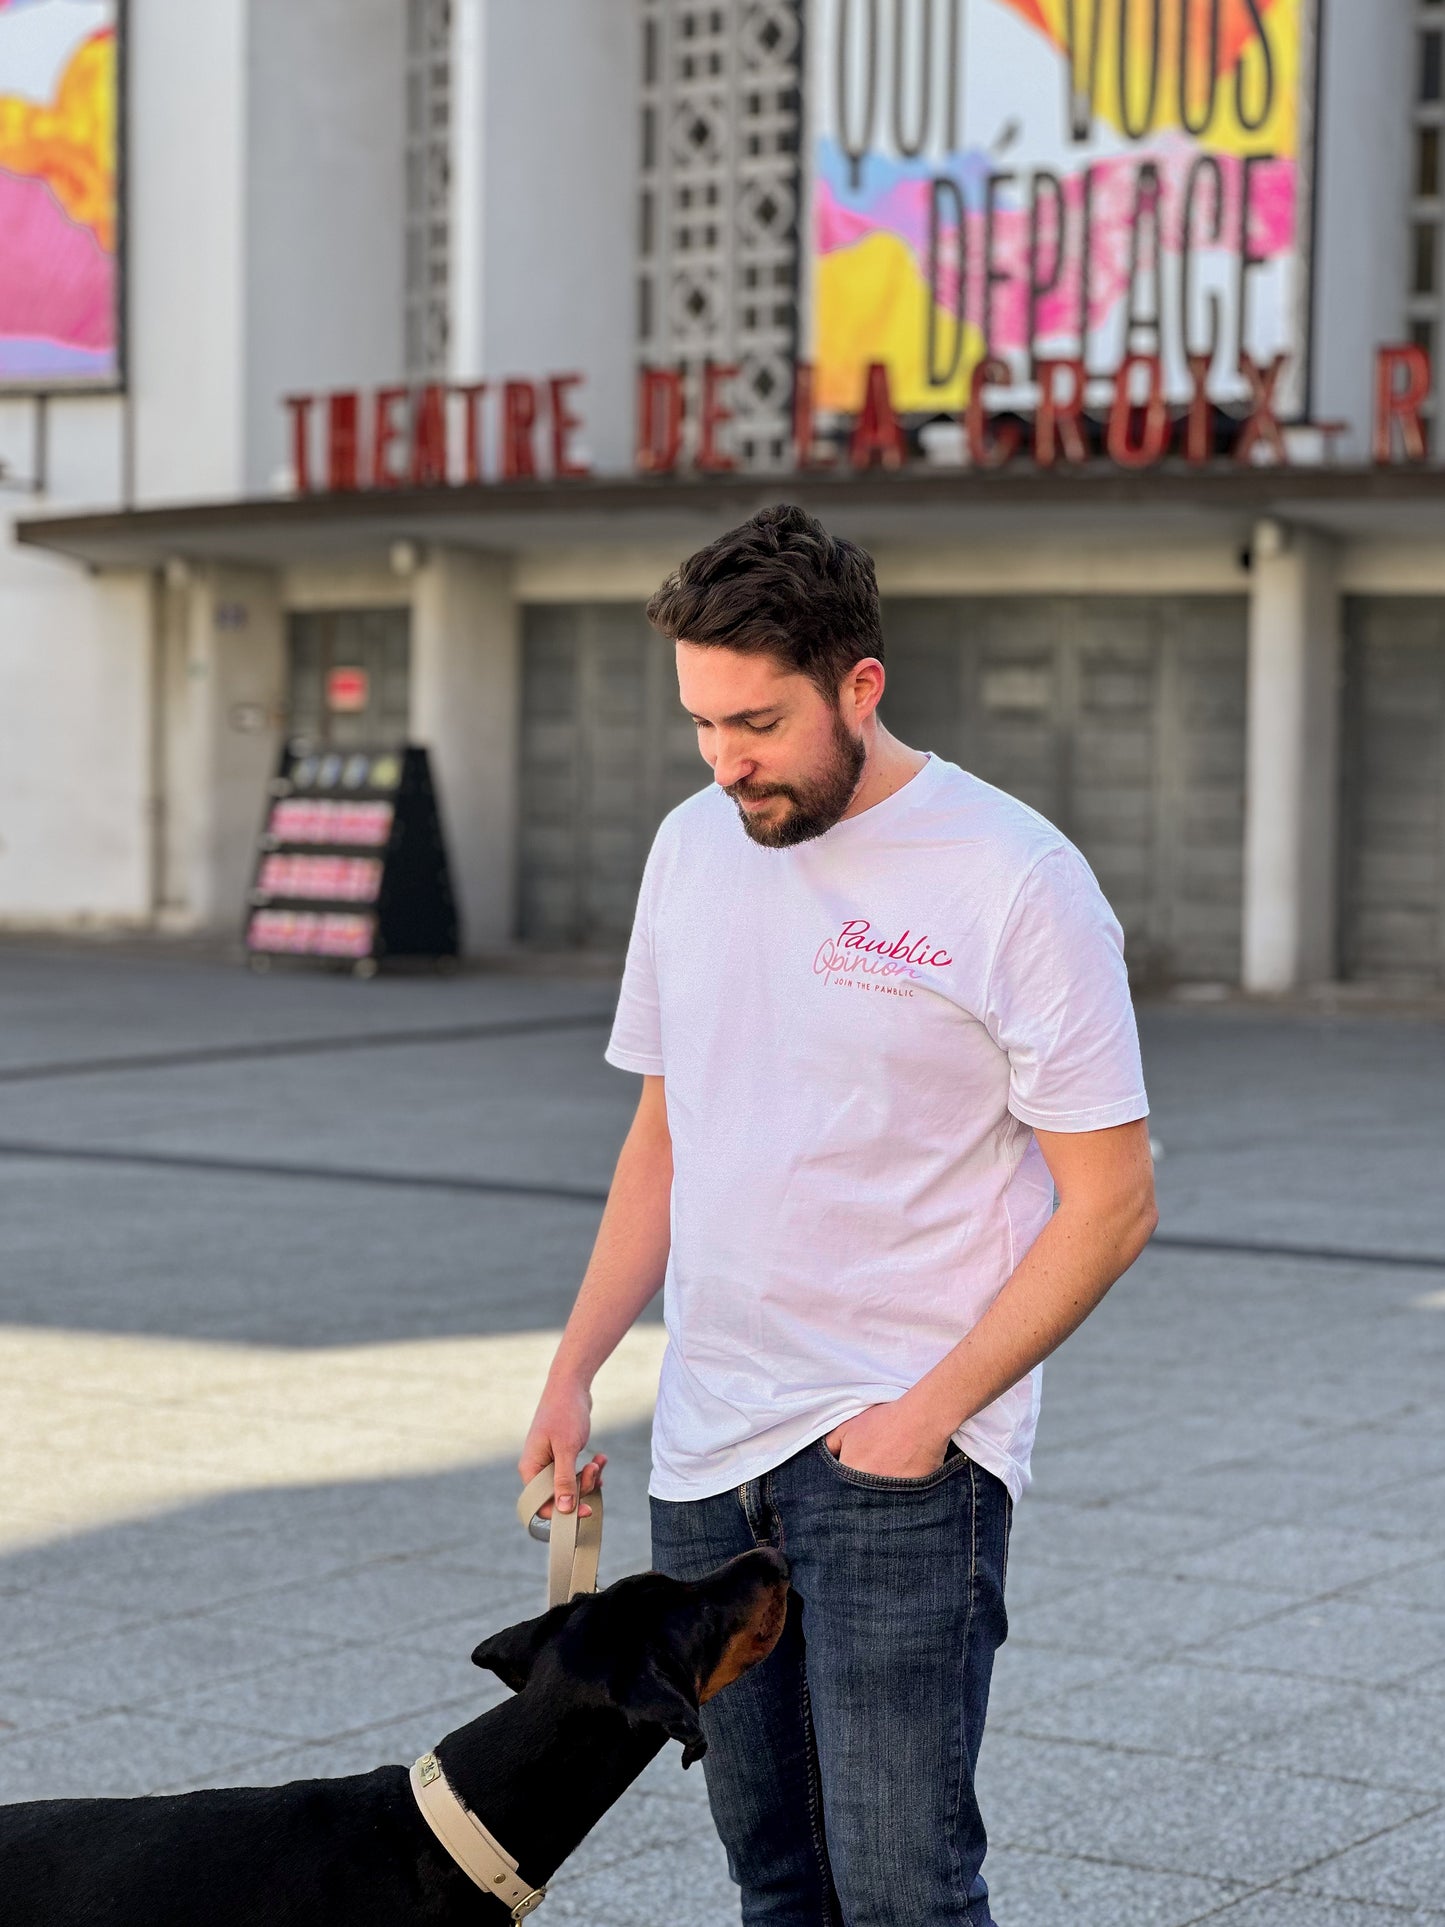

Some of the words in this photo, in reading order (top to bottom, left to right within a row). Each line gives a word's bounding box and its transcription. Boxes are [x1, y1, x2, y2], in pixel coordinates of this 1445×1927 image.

[926, 118, 1277, 390] DÉPLACE
[284, 371, 590, 491] THEATRE
[637, 361, 742, 470] DE
[793, 361, 907, 468] LA
[813, 938, 922, 986] Opinion
[837, 919, 953, 967] Pawblic
[834, 977, 853, 987] JOIN
[857, 981, 871, 991] THE
[875, 984, 914, 998] PAWBLIC
